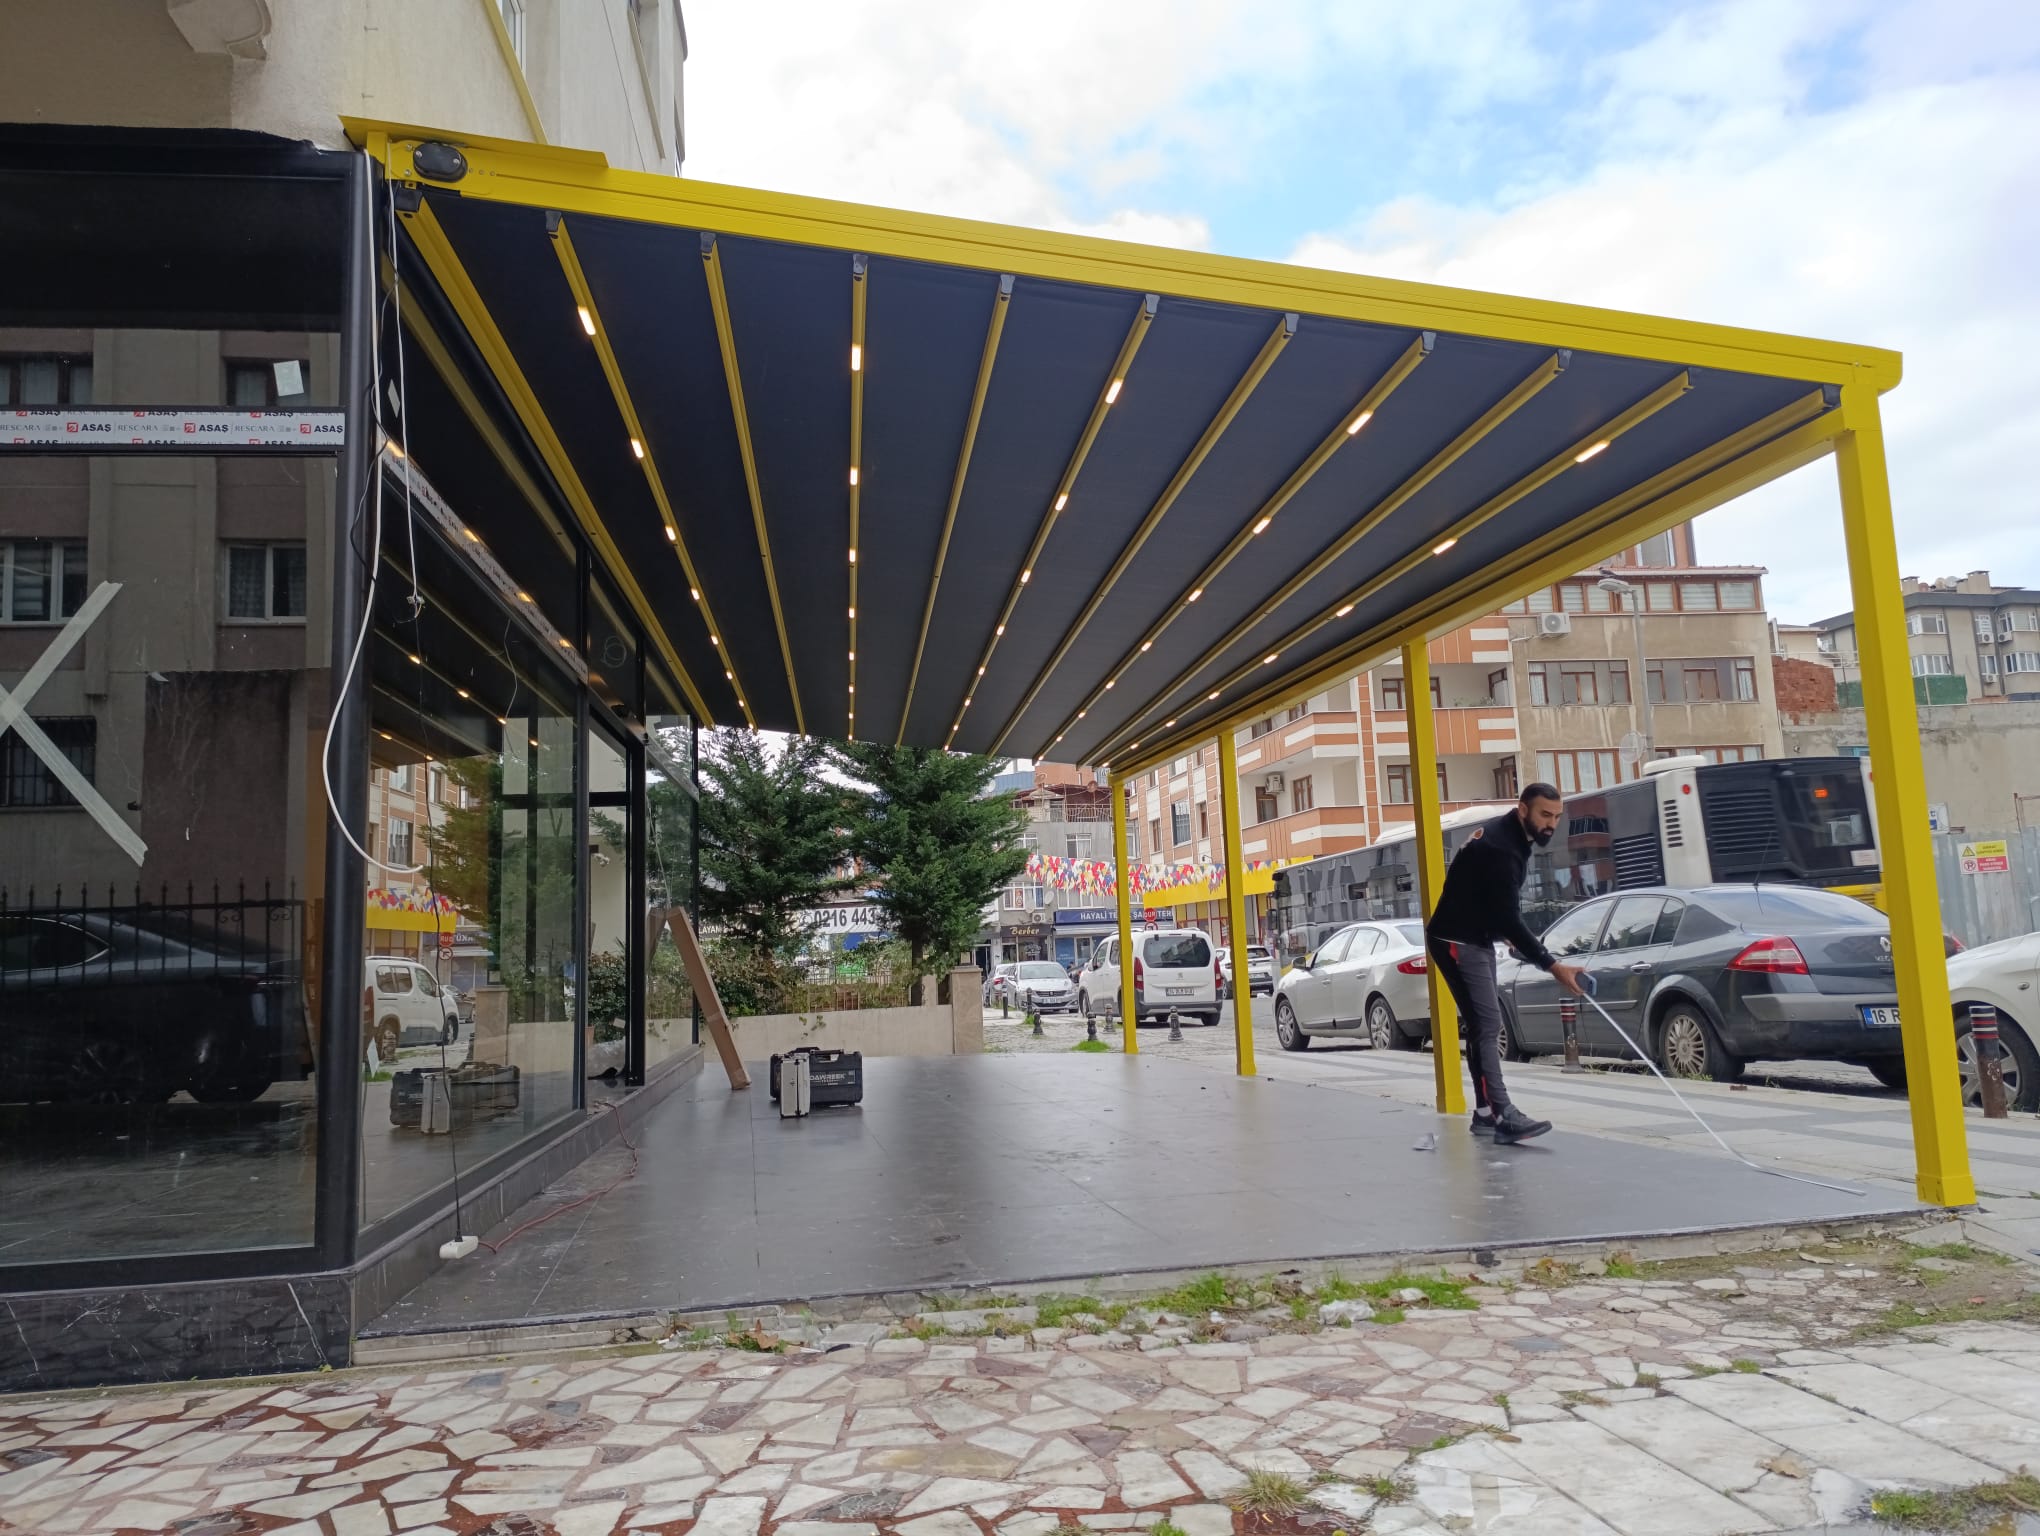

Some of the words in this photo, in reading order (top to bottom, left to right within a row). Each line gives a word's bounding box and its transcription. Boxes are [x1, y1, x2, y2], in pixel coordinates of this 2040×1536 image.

[81, 423, 112, 432] ASAŞ
[198, 424, 229, 433] ASAŞ
[314, 425, 344, 433] ASAŞ
[814, 909, 848, 928] 0216
[1080, 910, 1107, 920] HAYALİ
[1010, 926, 1040, 935] Berber
[1871, 1009, 1887, 1023] 16
